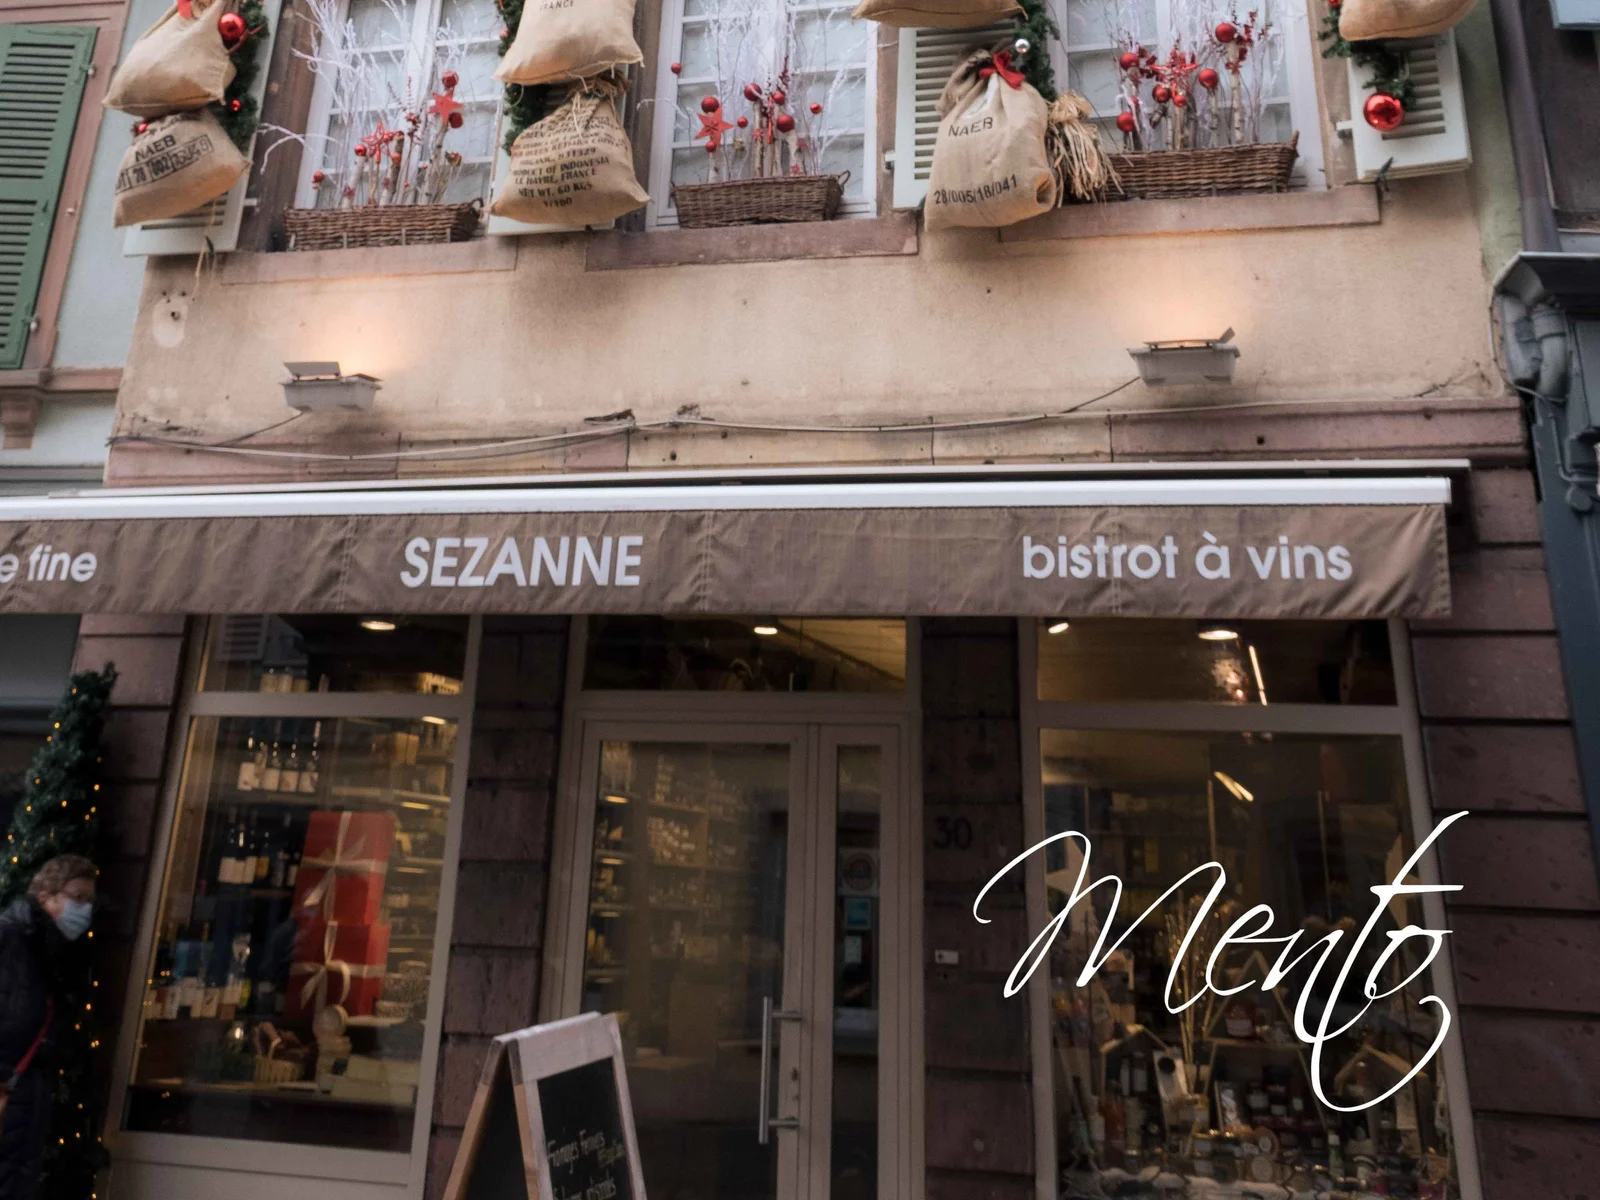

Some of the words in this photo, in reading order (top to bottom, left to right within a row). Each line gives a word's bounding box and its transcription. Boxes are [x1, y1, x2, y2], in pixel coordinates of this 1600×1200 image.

[948, 116, 994, 138] NAEB
[135, 134, 176, 163] NAEB
[560, 156, 610, 171] INDONESIA
[560, 167, 597, 182] FRANCE
[934, 173, 1018, 206] 28/005/18/041
[518, 187, 535, 198] NET
[27, 543, 98, 583] fine
[400, 536, 643, 587] SEZANNE
[1022, 534, 1177, 580] bistrot
[1195, 531, 1231, 580] à
[1246, 535, 1353, 581] vins
[932, 815, 974, 851] 30
